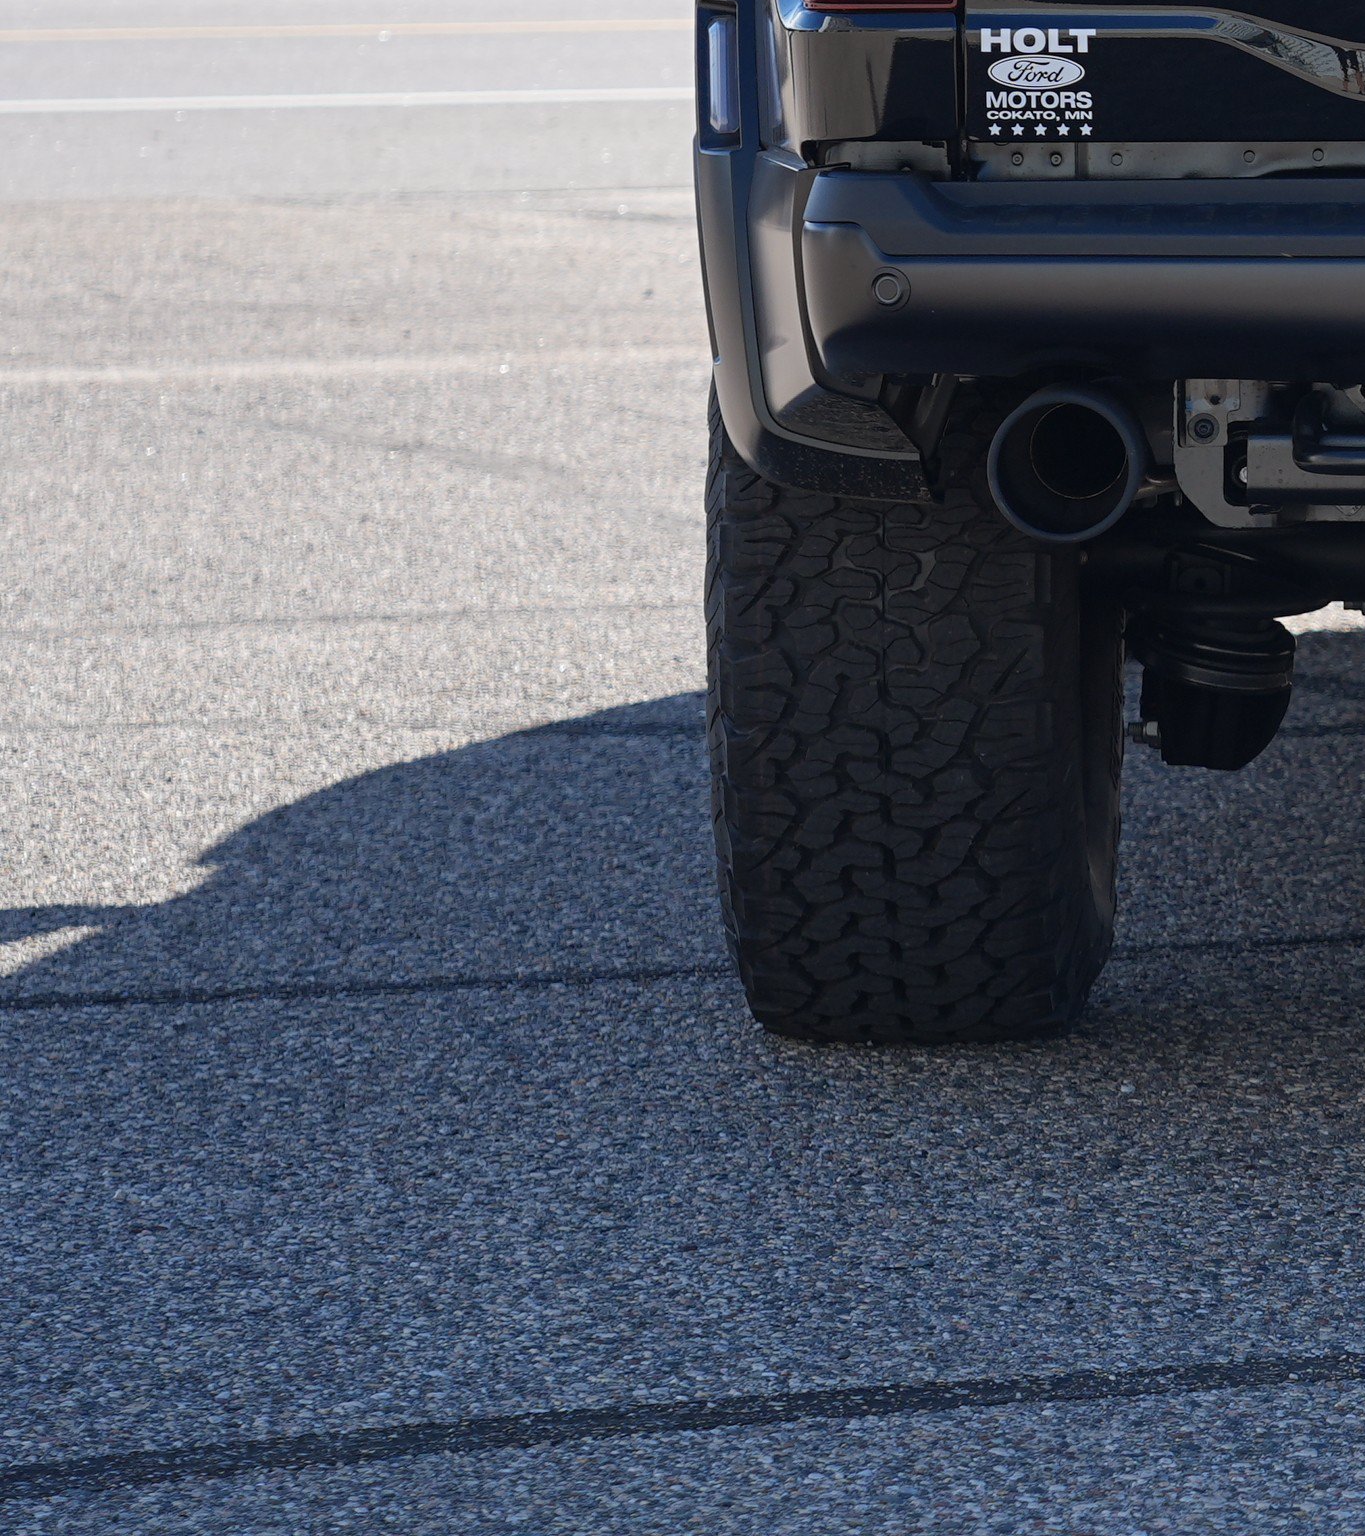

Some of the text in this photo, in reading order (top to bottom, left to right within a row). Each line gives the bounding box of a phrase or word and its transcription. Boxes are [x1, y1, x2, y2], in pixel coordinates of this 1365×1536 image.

[980, 27, 1096, 54] HOLT
[1007, 59, 1065, 83] Ford
[985, 91, 1093, 109] MOTORS
[986, 110, 1093, 121] COKATO, MN
